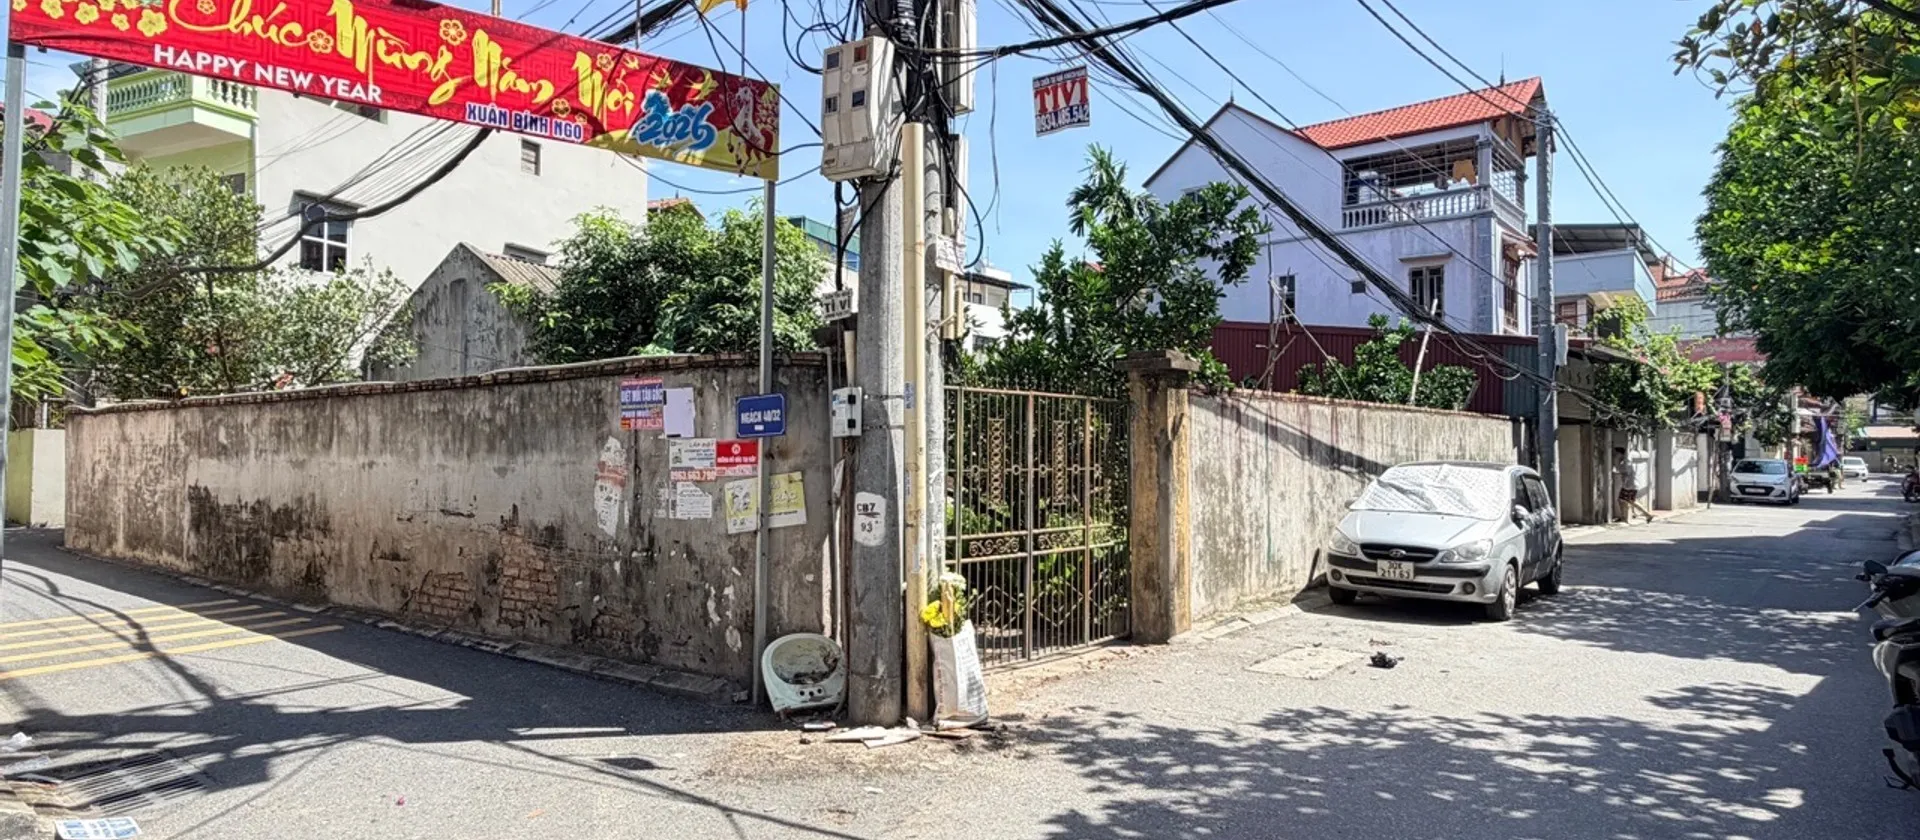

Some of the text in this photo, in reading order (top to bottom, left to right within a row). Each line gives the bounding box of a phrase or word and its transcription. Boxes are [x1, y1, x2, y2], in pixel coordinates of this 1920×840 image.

[153, 44, 382, 103] HAPPY NEW YEAR
[168, 0, 308, 47] Chúc
[472, 28, 554, 103] Năm
[573, 51, 634, 131] Mới
[1034, 78, 1088, 114] TIVI
[467, 102, 583, 142] XUÂN BÍNH NGỌ
[633, 101, 717, 152] 2026
